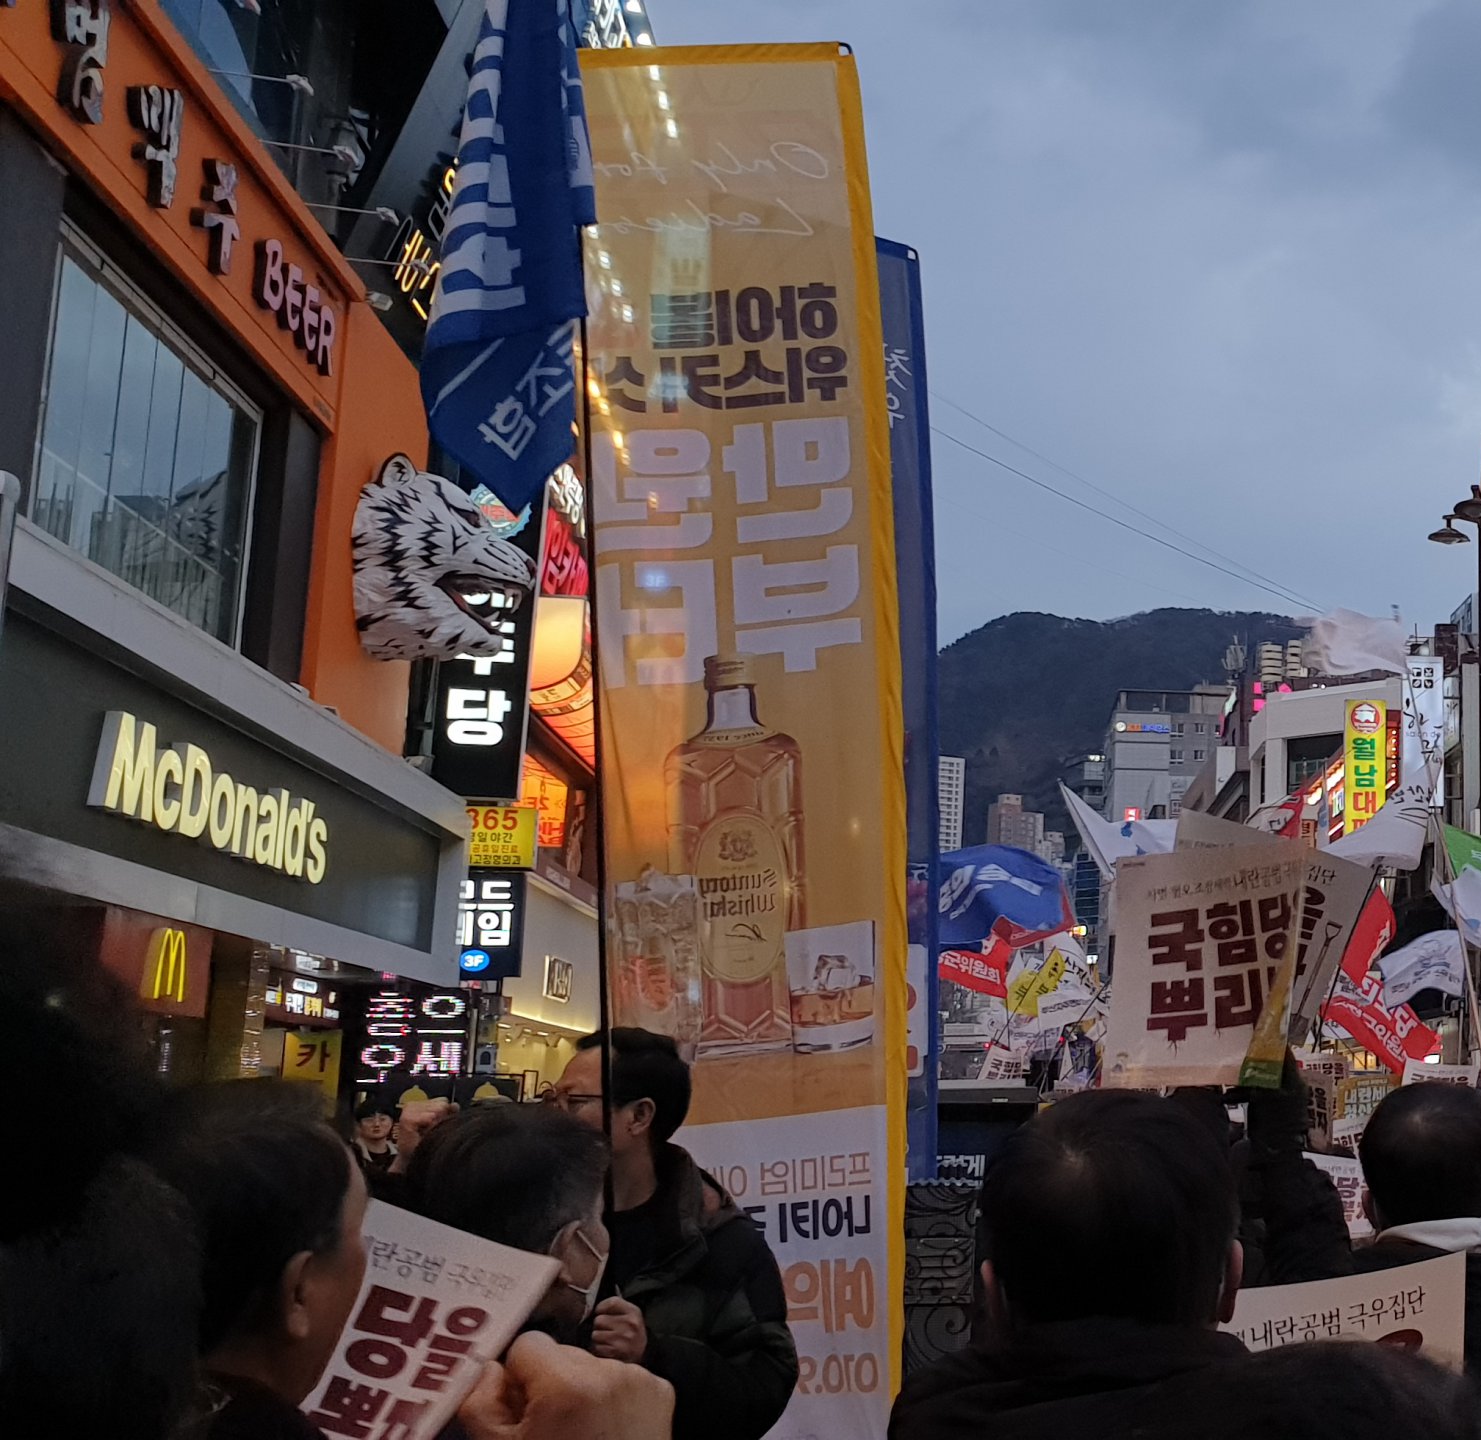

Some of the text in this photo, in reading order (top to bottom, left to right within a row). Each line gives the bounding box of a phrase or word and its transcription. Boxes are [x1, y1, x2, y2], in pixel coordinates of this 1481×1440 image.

[261, 238, 337, 376] BEER
[104, 711, 330, 886] McDonald's
[466, 808, 519, 831] 365
[490, 832, 513, 844] 야간
[464, 954, 487, 967] 3F
[1147, 966, 1277, 1042] 뿌리
[297, 1040, 331, 1073] 카
[1250, 1307, 1341, 1347] 내란공범
[1347, 1285, 1426, 1331] 극우집단
